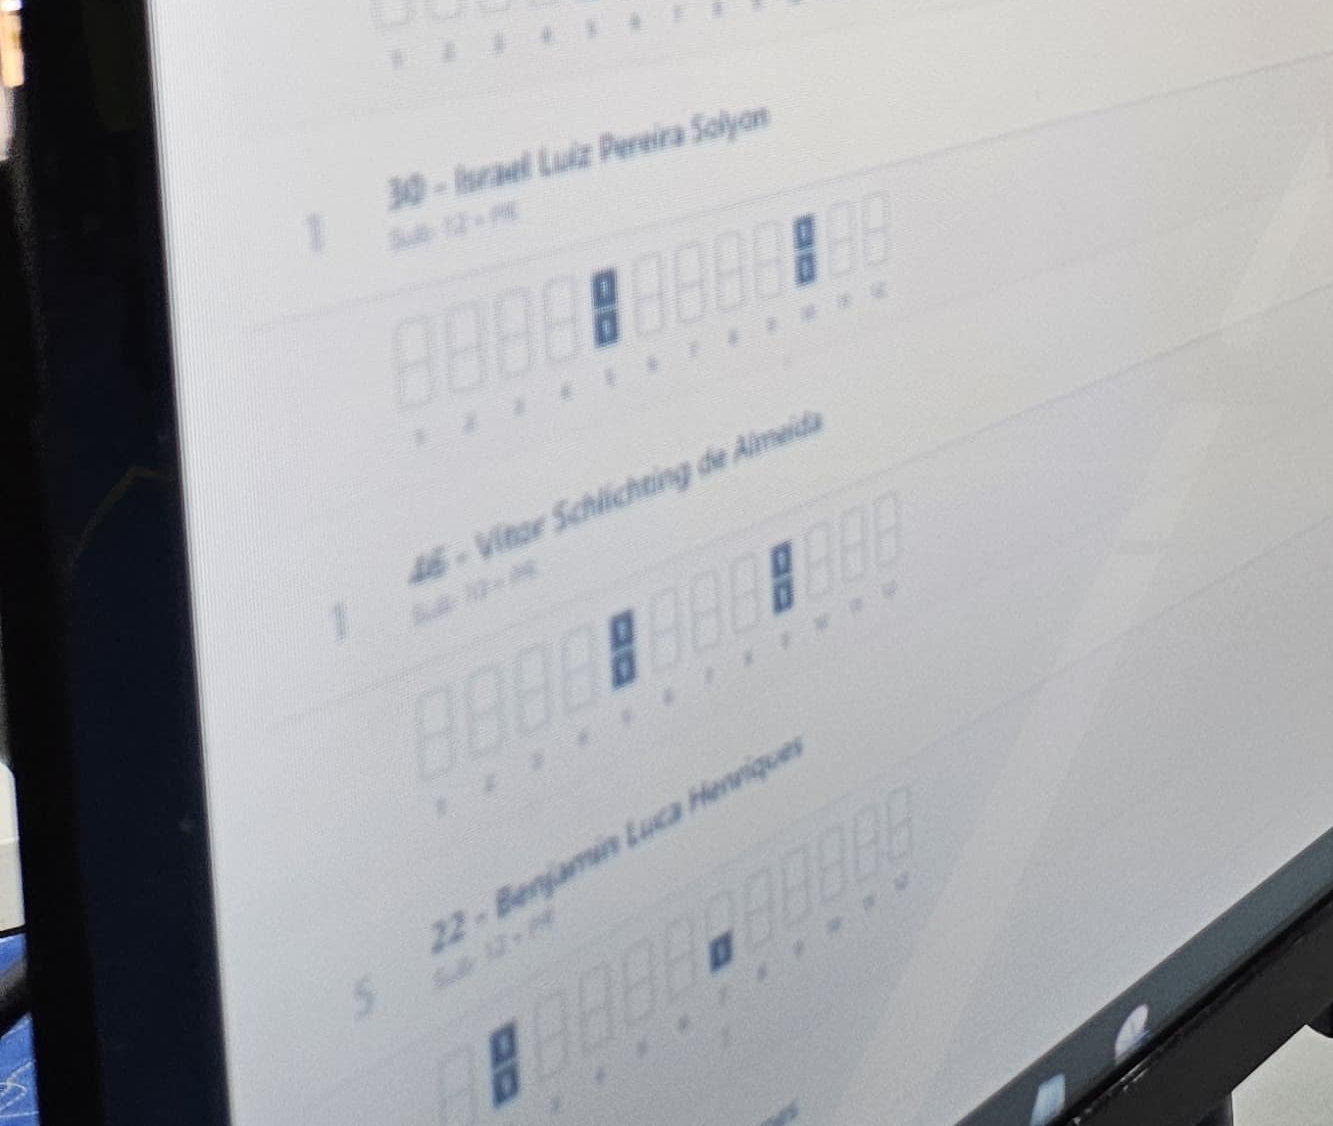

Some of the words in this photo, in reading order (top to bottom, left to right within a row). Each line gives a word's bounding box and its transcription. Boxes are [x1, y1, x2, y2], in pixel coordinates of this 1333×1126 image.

[388, 171, 428, 212] 30
[454, 149, 533, 200] Israel
[538, 140, 594, 179] Luiz
[598, 118, 687, 164] Pereira
[474, 516, 546, 562] Vitor
[550, 456, 694, 531] Schlichting
[697, 444, 729, 479] de
[732, 409, 825, 465] Almeida
[431, 909, 465, 955] 22
[493, 829, 622, 922] Benjamin
[626, 796, 685, 847] Luca
[688, 733, 806, 814] Henriques
